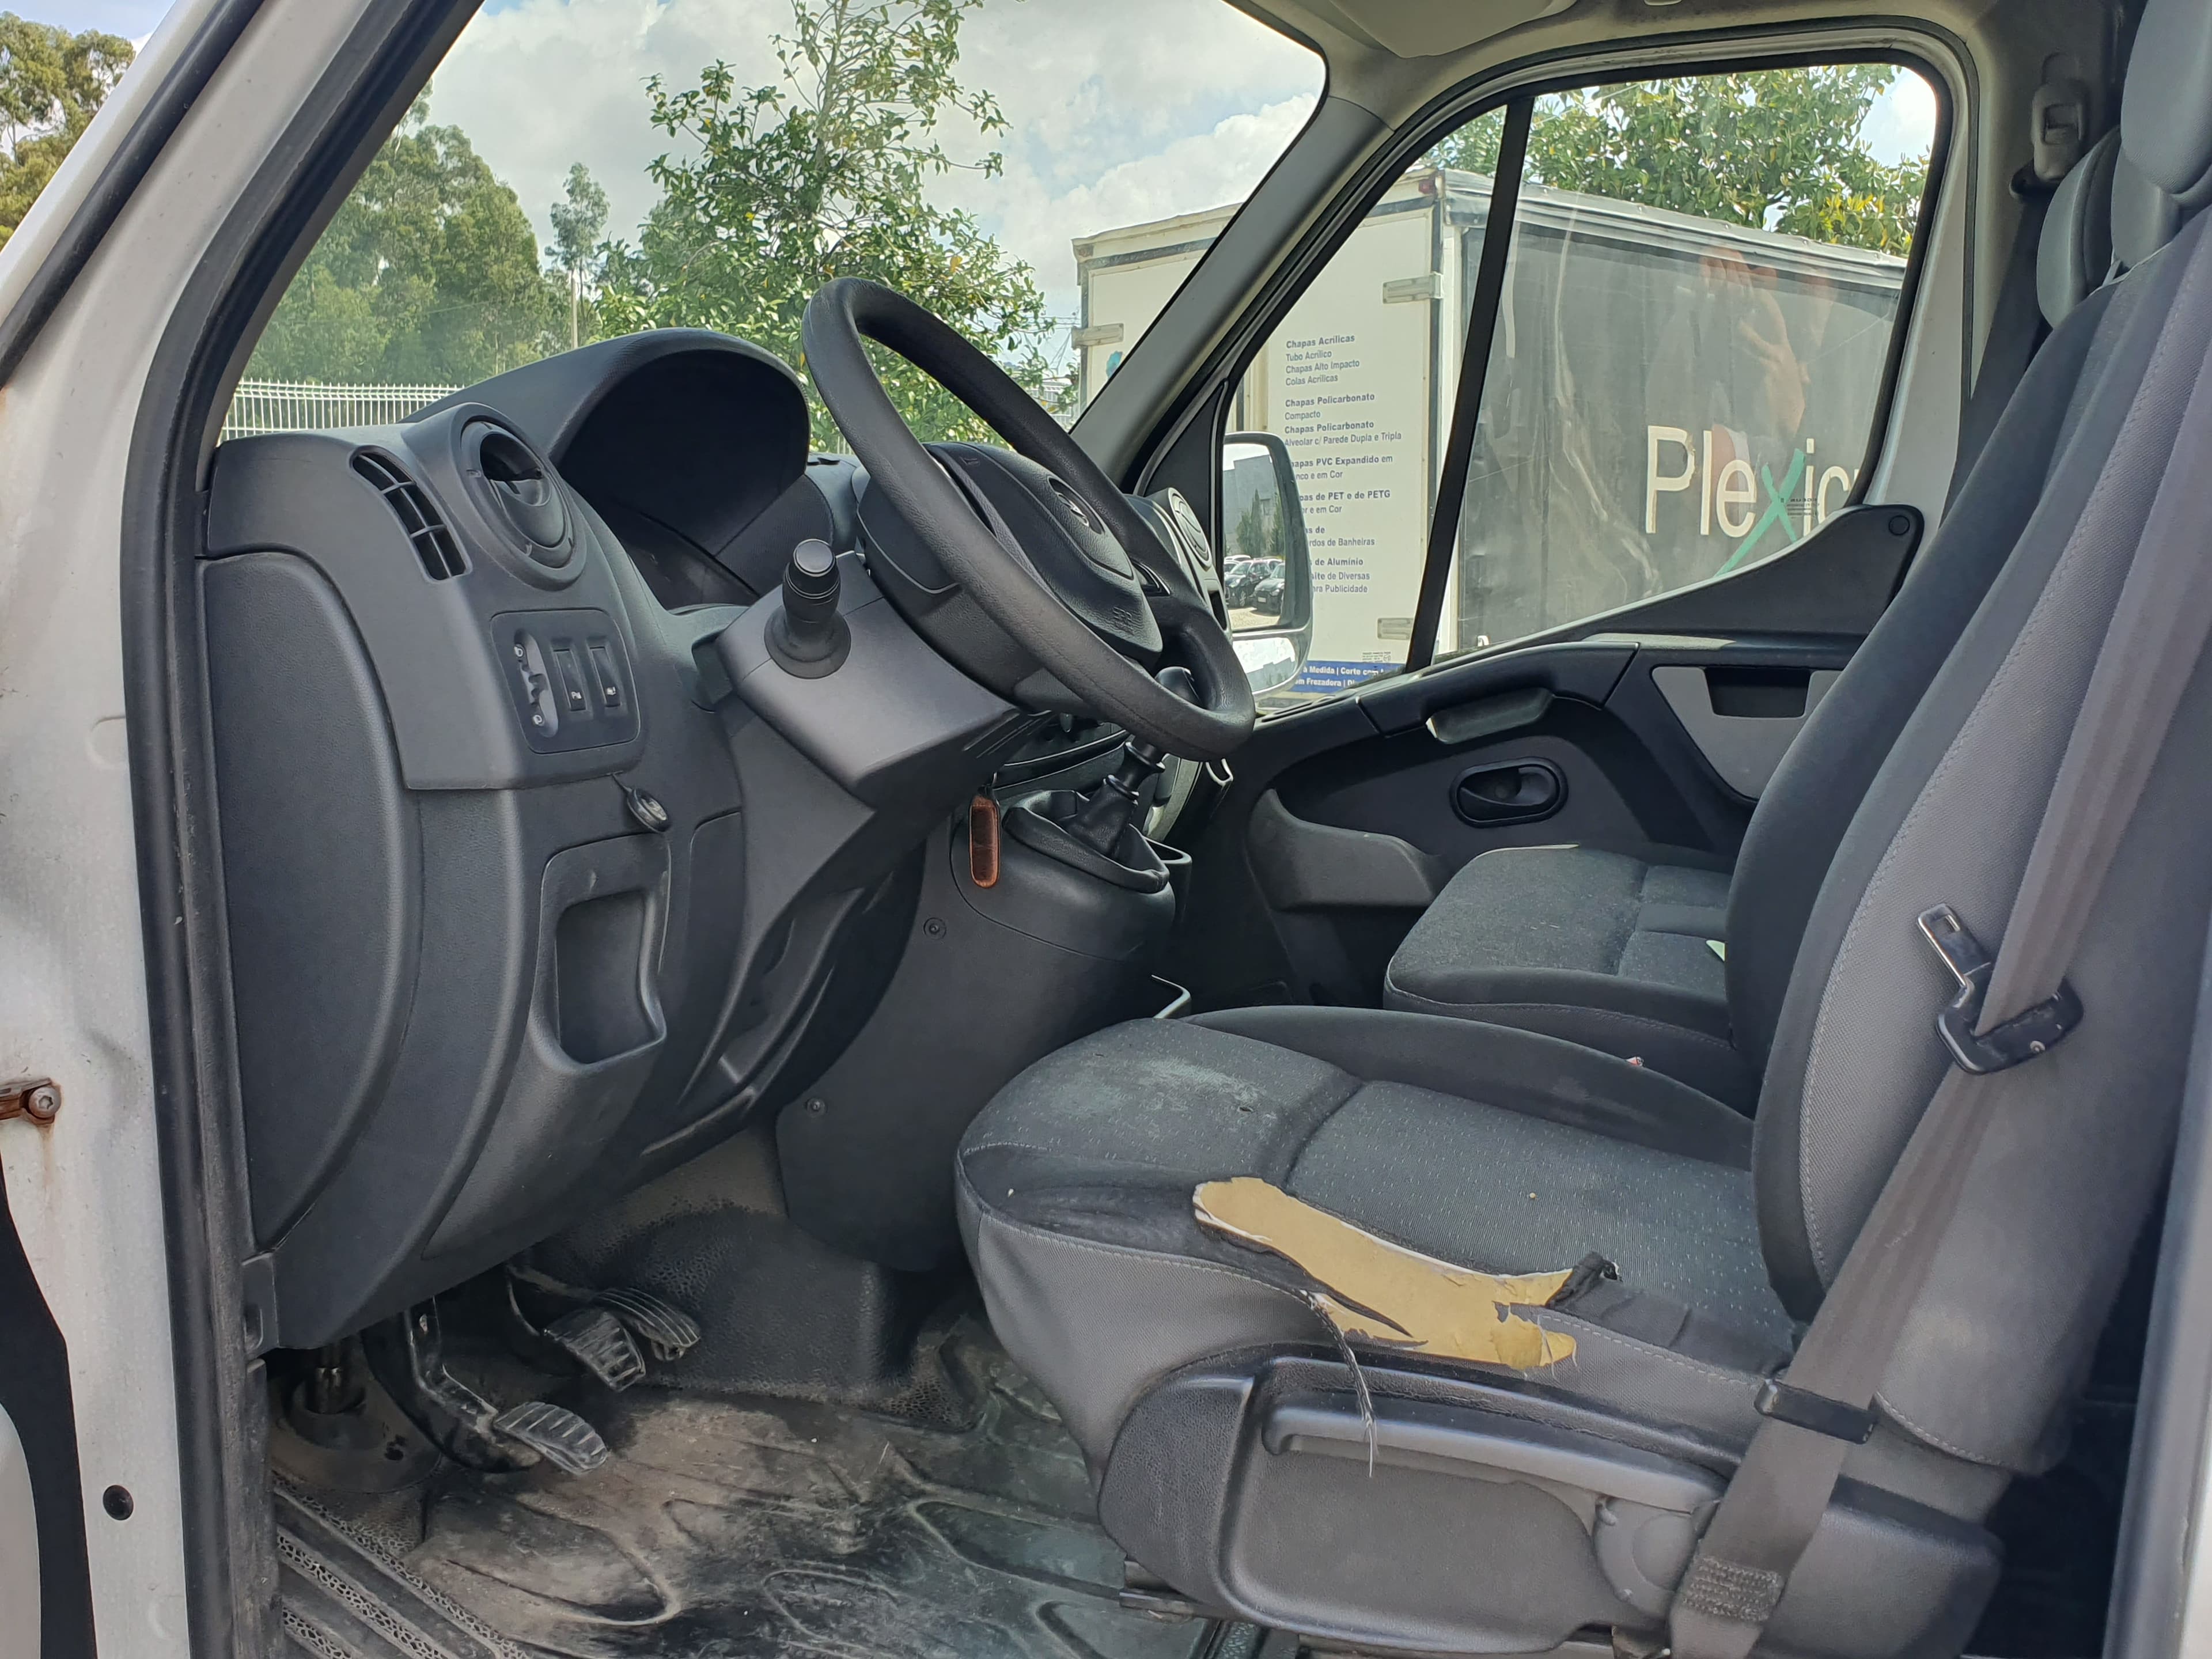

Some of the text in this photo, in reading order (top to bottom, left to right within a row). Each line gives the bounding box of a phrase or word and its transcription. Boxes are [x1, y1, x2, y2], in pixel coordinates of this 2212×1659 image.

[1286, 339, 1316, 349] Chapas
[1286, 353, 1303, 362] Tubo
[1286, 359, 1360, 374] Chapas Alto Impacto
[1286, 377, 1306, 386] Colas
[1285, 393, 1375, 408] Chapas Policarbonato
[1285, 411, 1321, 421] Compacto
[1285, 421, 1374, 434] Chapas Policarbonato
[1285, 437, 1313, 447] Alveolar
[1315, 437, 1322, 446] c/
[1323, 435, 1349, 445] Parede
[1350, 434, 1372, 444] Dupla
[1381, 431, 1402, 442] Tripla
[1316, 458, 1333, 466] PVC
[1335, 455, 1380, 467] Expandido
[1330, 470, 1343, 479] Cor
[1316, 492, 1325, 501] de
[1328, 492, 1344, 501] PET
[1354, 491, 1365, 499] de
[1368, 490, 1391, 499] PETG
[1329, 505, 1342, 513] Cor
[1315, 525, 1325, 534] de
[1327, 539, 1336, 547] de
[1338, 538, 1375, 547] Banheiras
[1315, 558, 1325, 566] de
[1327, 571, 1336, 579] de
[1339, 571, 1370, 580] Diversas
[1325, 584, 1368, 593] Publicidade
[1309, 666, 1335, 675] Medida
[1340, 667, 1361, 675] Corte
[1306, 677, 1342, 687] Frezadora
